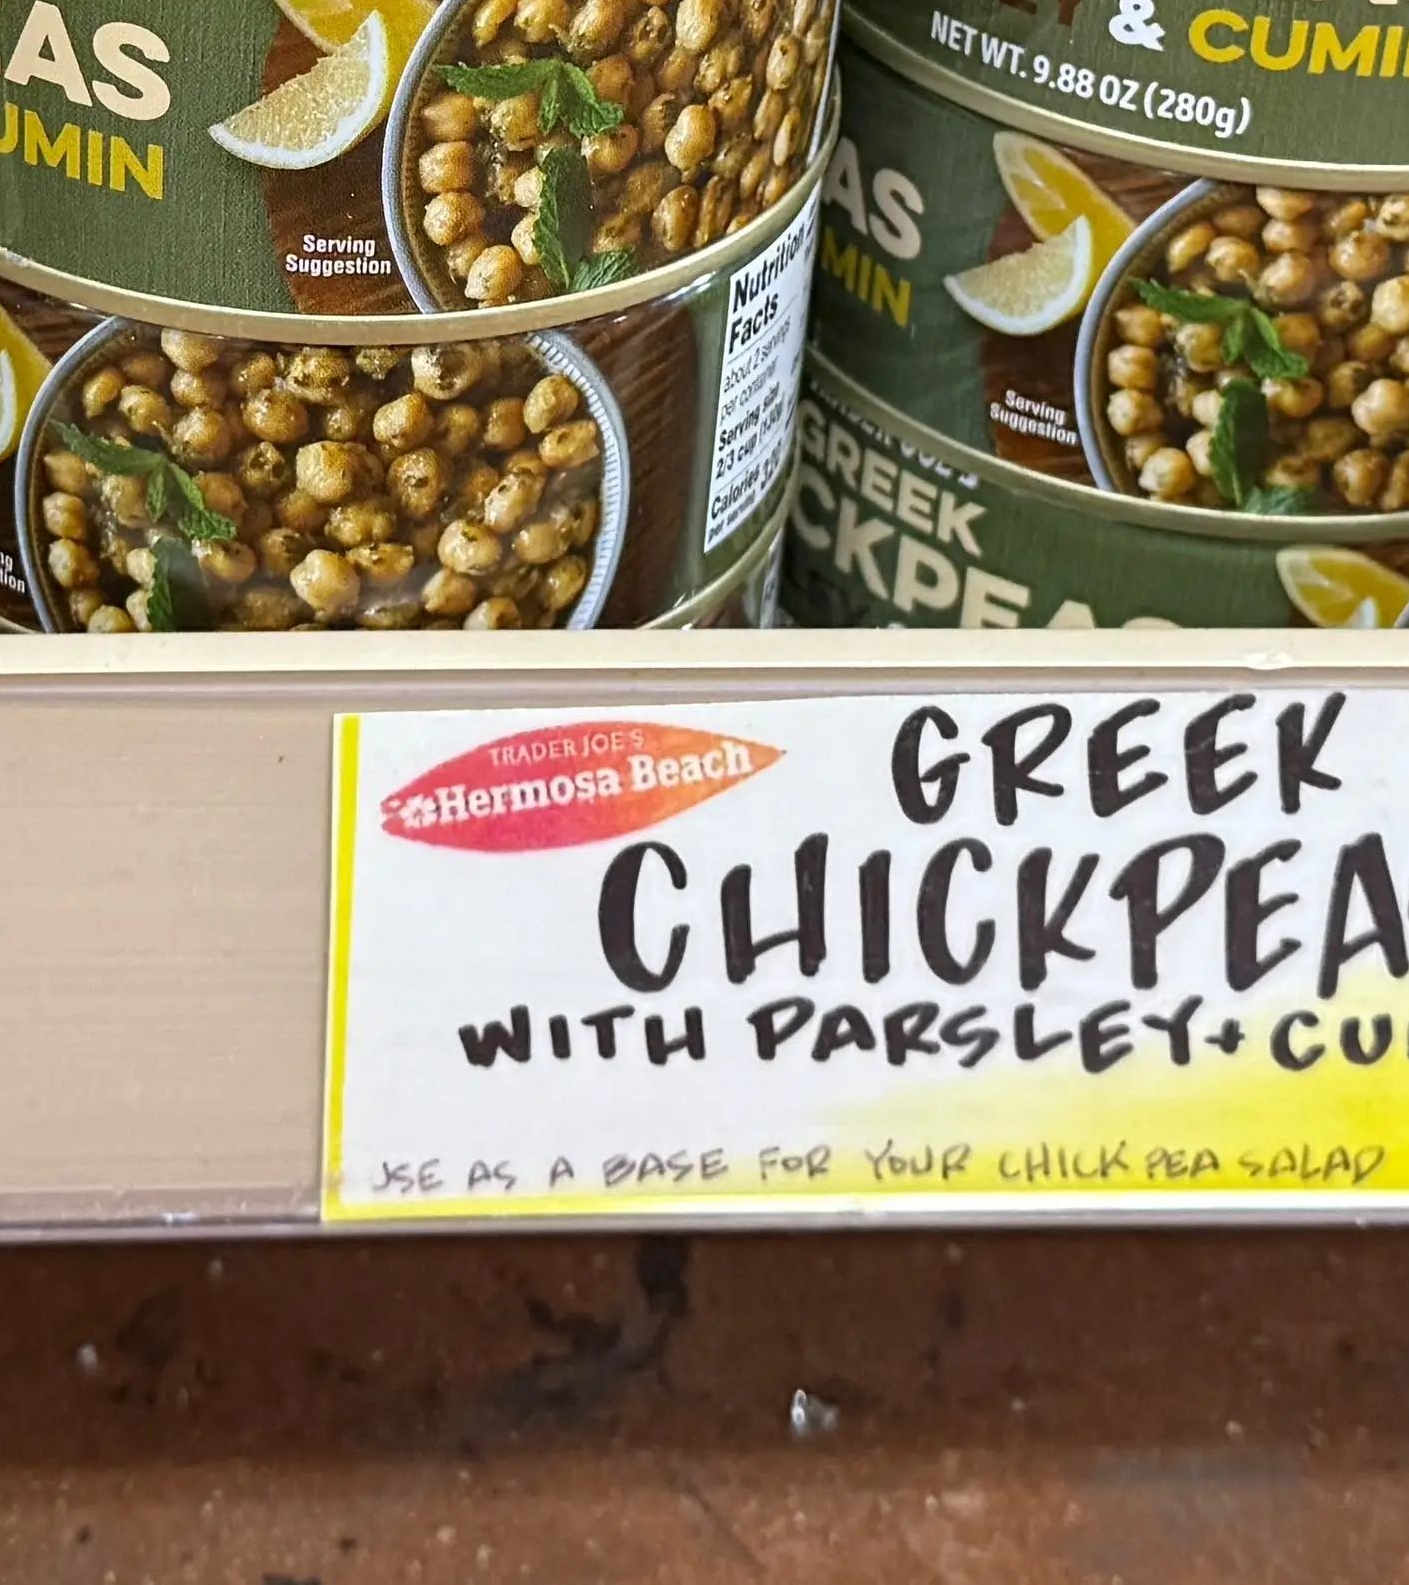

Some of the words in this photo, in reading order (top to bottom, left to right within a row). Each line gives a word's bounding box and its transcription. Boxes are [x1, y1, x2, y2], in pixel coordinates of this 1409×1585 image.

[931, 9, 980, 53] NET
[980, 30, 1028, 79] WT.
[1033, 54, 1094, 99] 9.88
[1099, 75, 1140, 111] OZ
[1143, 81, 1252, 140] (280g)
[285, 254, 391, 277] Suggestion
[303, 234, 375, 257] Serving
[728, 290, 779, 354] Facts
[989, 401, 1078, 447] Suggestion
[1004, 390, 1067, 428] Serving
[796, 398, 987, 559] GREEK
[489, 739, 575, 767] TRADER
[581, 730, 646, 758] JOE'S
[891, 691, 1347, 826] GREEK
[436, 769, 622, 825] Hermosa
[627, 740, 754, 792] Beach
[458, 1004, 707, 1067] WITH
[467, 1159, 518, 1192] AS
[549, 1155, 575, 1189] A
[602, 1147, 730, 1189] BASE
[757, 1143, 832, 1181] FOR
[864, 1137, 972, 1182] YOUR
[1238, 1144, 1386, 1186] SALAD
